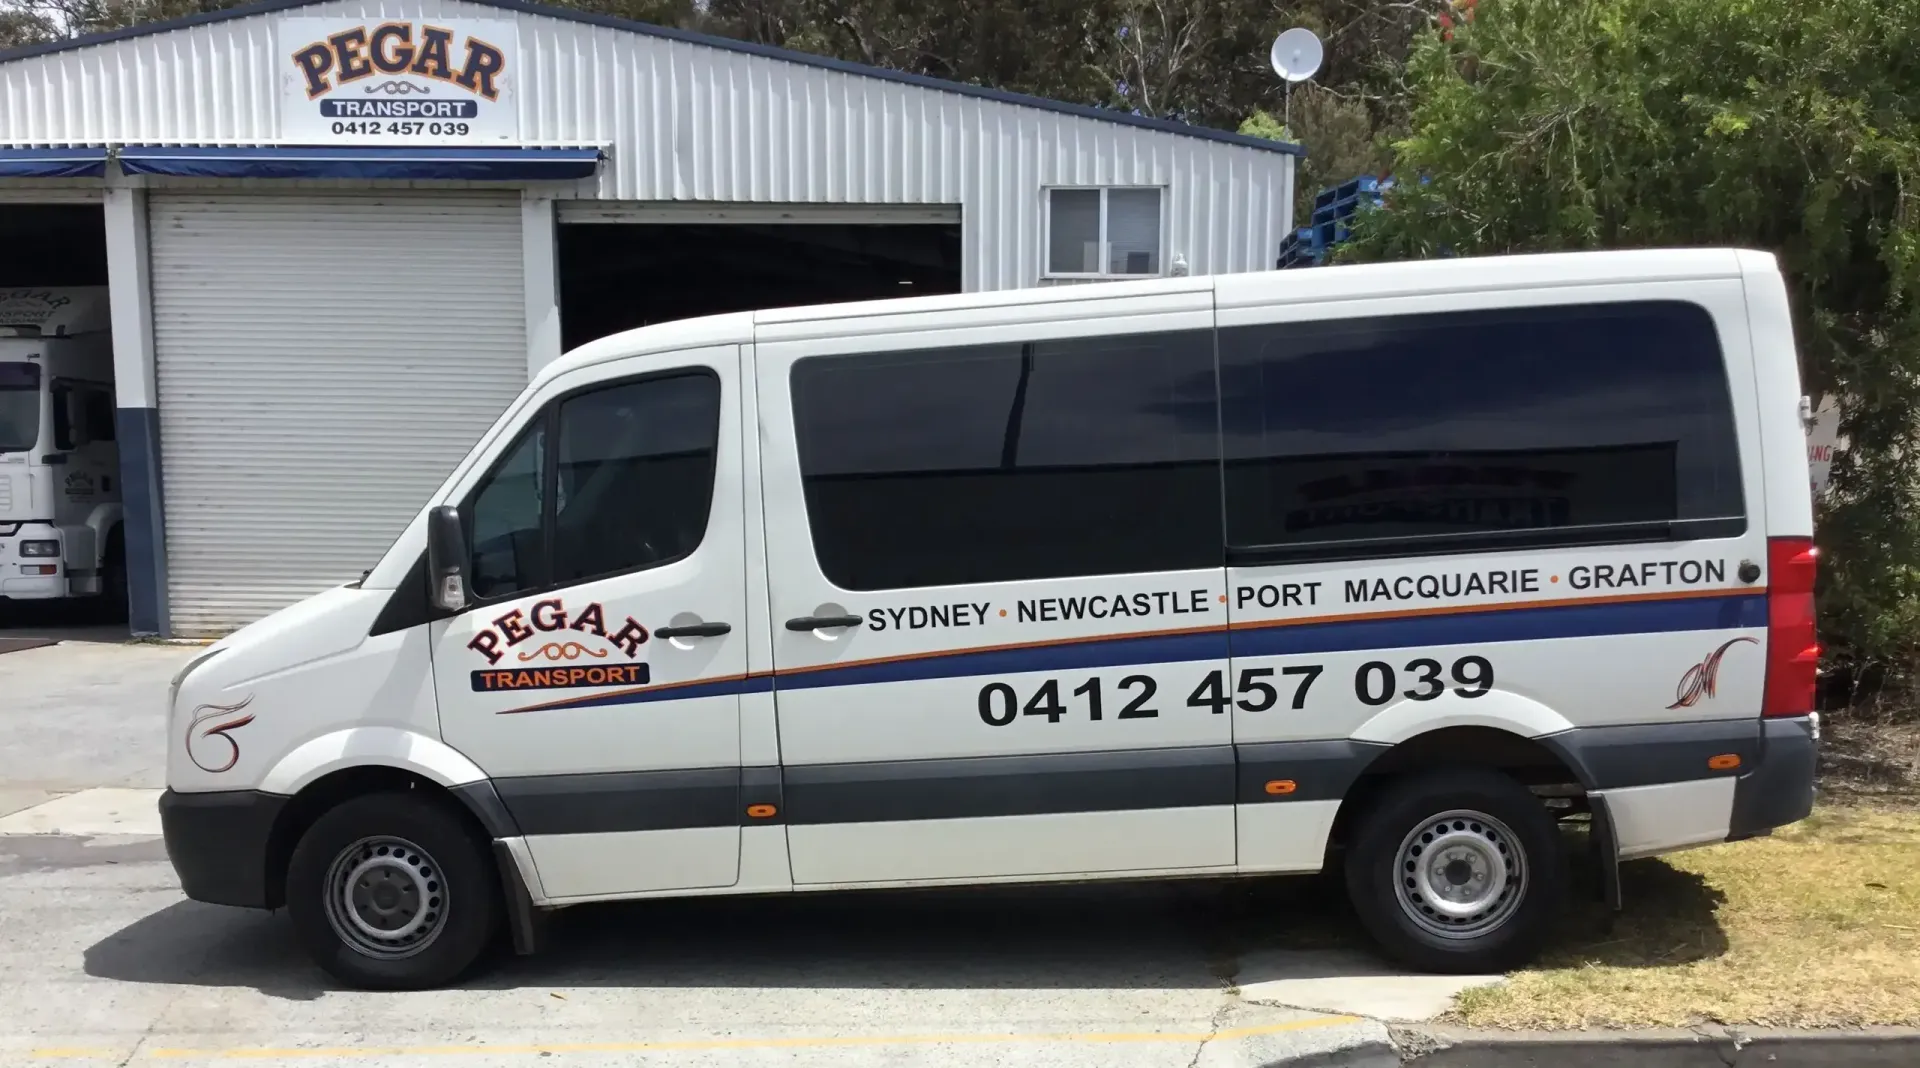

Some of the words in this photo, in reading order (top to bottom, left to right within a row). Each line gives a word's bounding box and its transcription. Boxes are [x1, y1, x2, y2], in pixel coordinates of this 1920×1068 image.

[292, 22, 505, 102] PEGAR
[331, 122, 382, 135] 0412
[387, 122, 425, 135] 457
[429, 122, 470, 136] 039
[332, 101, 467, 117] TRANSPORT
[1807, 445, 1831, 462] ING
[868, 602, 991, 632] SYDNEY
[1017, 589, 1210, 623] NEWCASTLE
[1237, 581, 1322, 610] PORT
[1344, 568, 1540, 604] MACQUARIE
[1568, 558, 1726, 590] GRAFTON
[466, 597, 650, 666] PEGAR
[480, 665, 640, 689] TRANSPORT
[977, 674, 1159, 727] 0412
[1186, 664, 1324, 715] 457
[1353, 655, 1495, 707] 039
